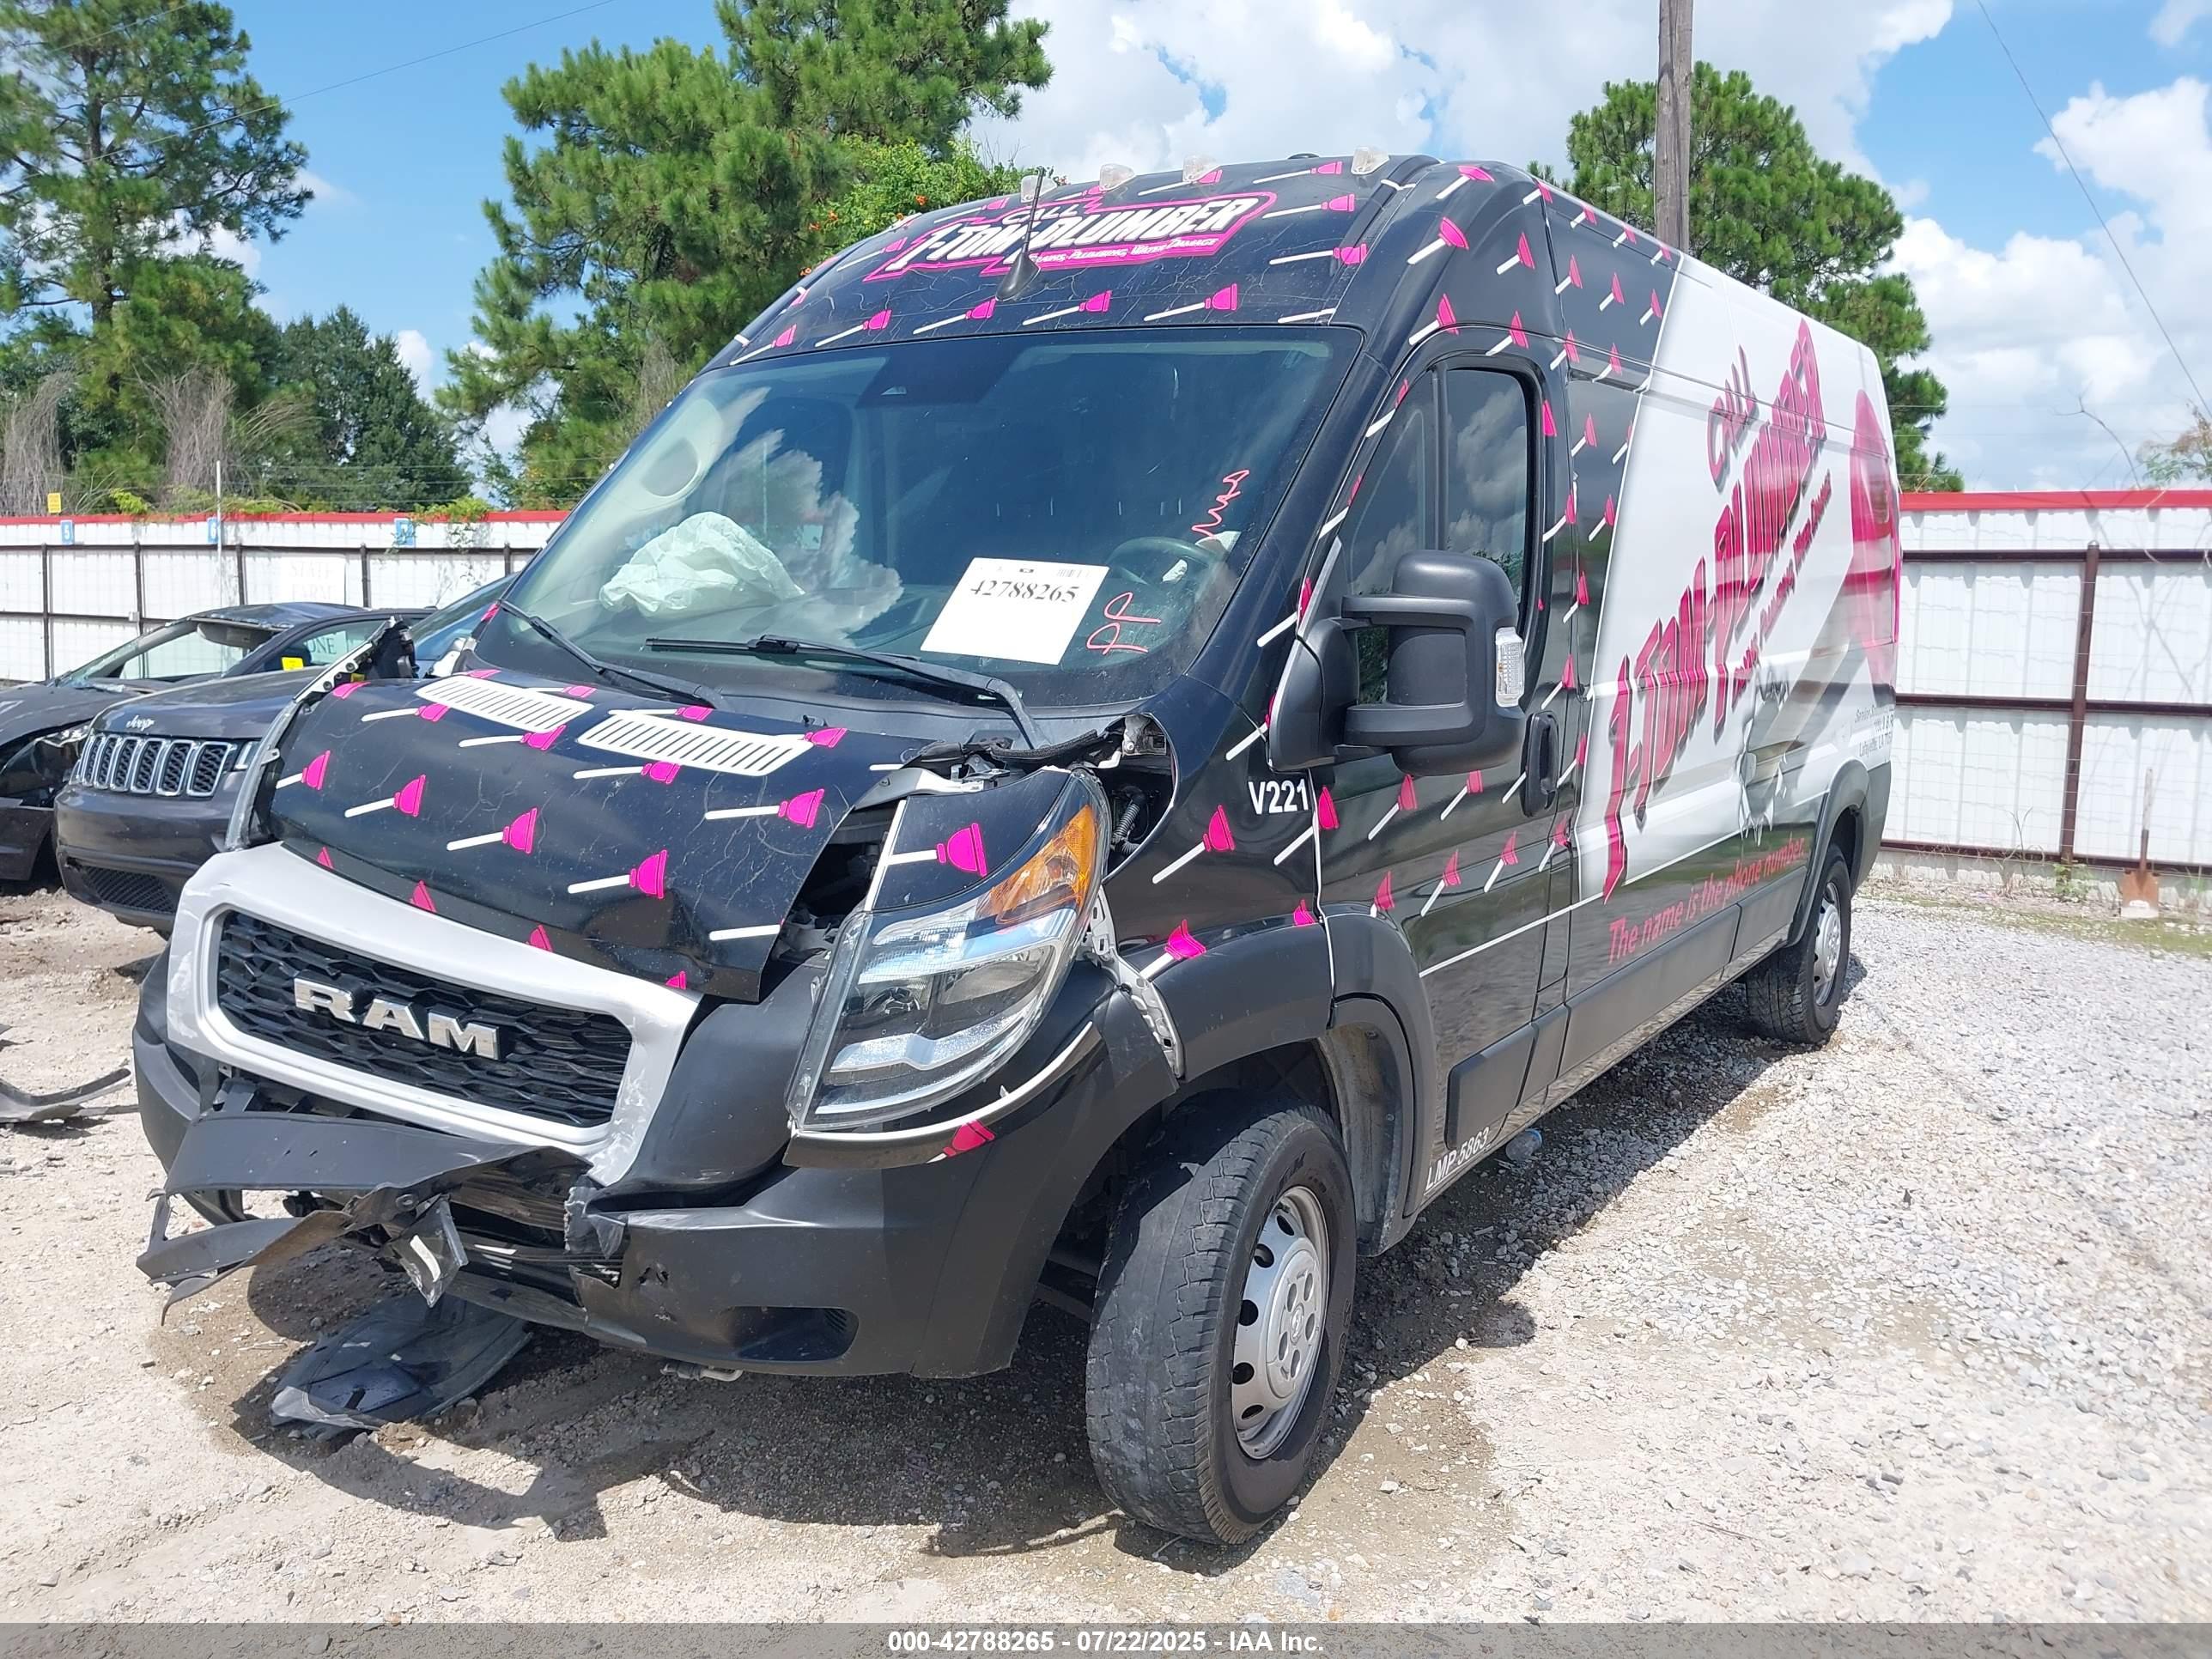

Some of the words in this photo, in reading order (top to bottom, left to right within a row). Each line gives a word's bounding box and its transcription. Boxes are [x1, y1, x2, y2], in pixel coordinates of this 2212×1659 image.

[1001, 204, 1079, 225] CALL
[970, 580, 1080, 603] 42788265
[1248, 778, 1310, 815] V221
[1607, 915, 1639, 965] The
[1640, 900, 1684, 946] name
[1685, 887, 1699, 921] is
[1699, 872, 1723, 914] the
[1723, 859, 1762, 912] phone
[293, 977, 500, 1060] RAM
[1425, 1149, 1458, 1192] LMP
[1457, 1126, 1490, 1166] 5863
